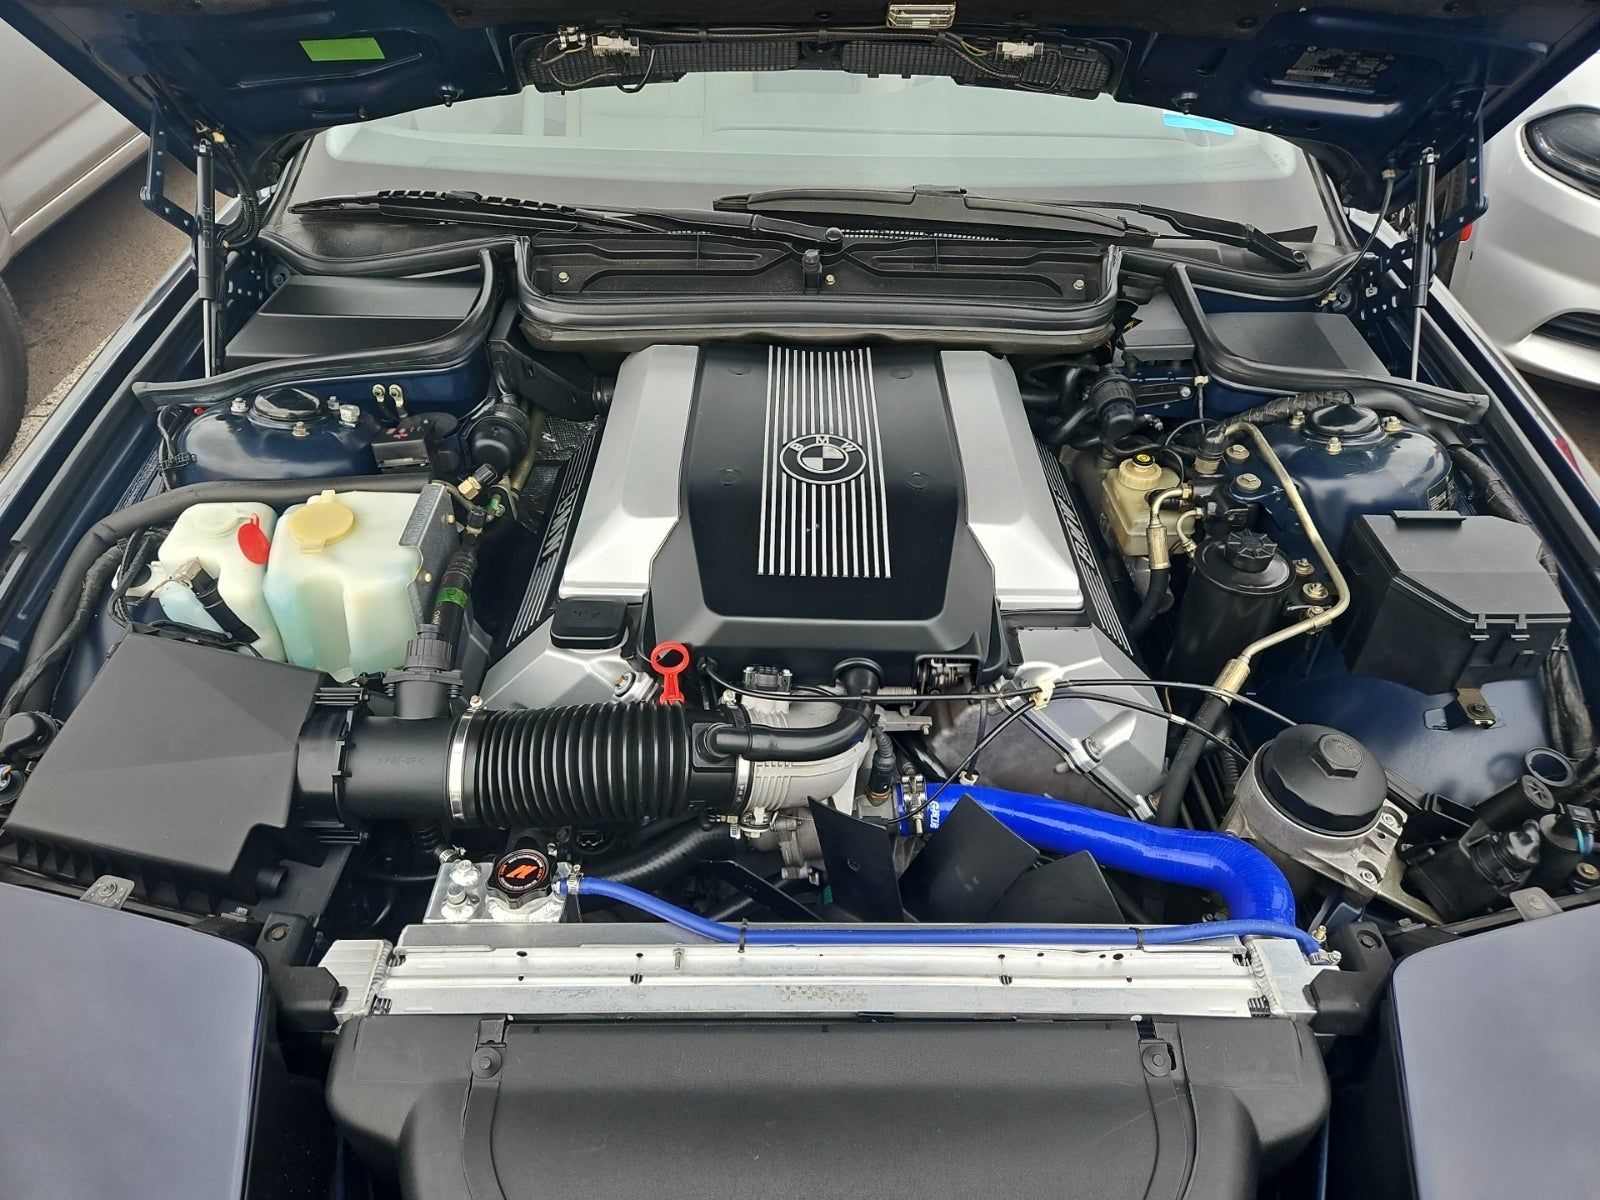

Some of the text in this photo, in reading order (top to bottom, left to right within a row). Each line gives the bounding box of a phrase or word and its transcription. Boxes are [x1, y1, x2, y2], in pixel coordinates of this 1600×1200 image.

[789, 435, 859, 453] BMW
[541, 489, 577, 558] BMW
[1057, 495, 1096, 570] BMW
